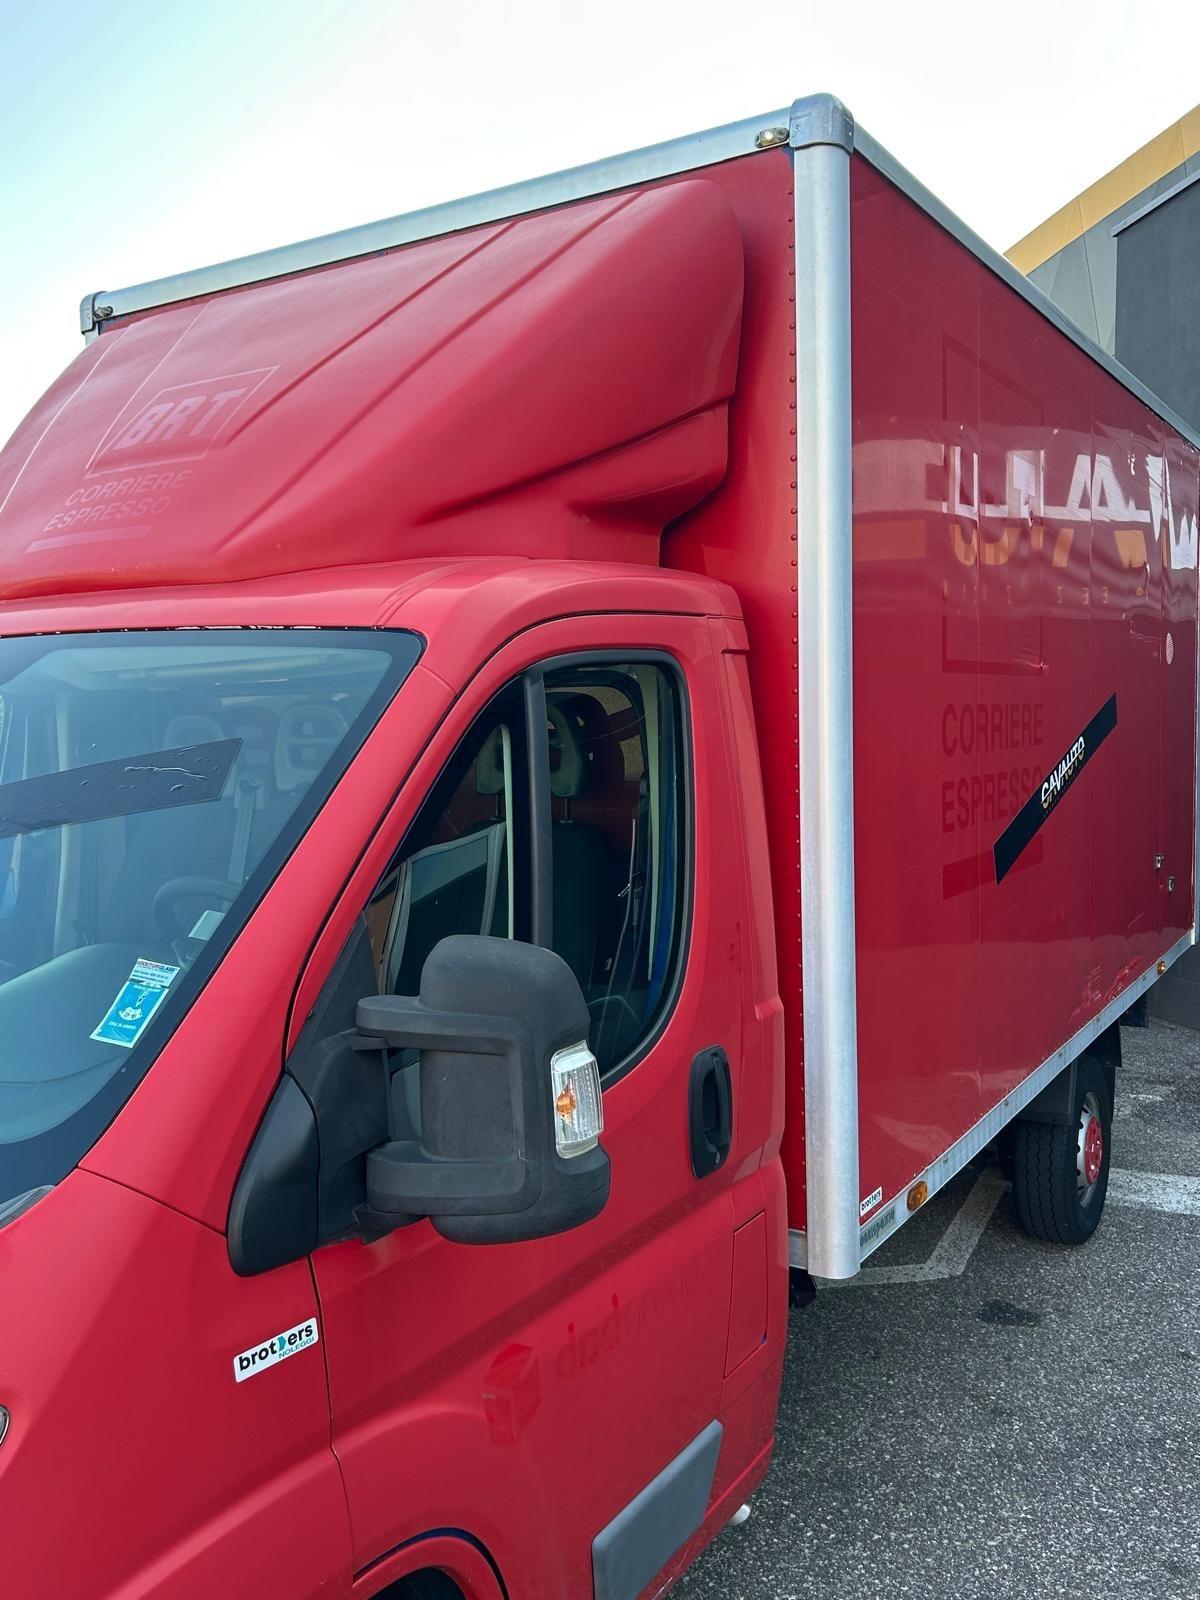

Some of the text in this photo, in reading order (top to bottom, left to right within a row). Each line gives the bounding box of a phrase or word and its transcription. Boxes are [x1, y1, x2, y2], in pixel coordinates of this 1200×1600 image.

[113, 387, 248, 450] BRT
[65, 470, 194, 507] CORRIERE
[42, 496, 173, 532] ESPRESSO
[942, 703, 1044, 758] CORRIERE
[1040, 736, 1085, 809] CAVAUTO
[278, 1336, 315, 1359] NOLEGGI
